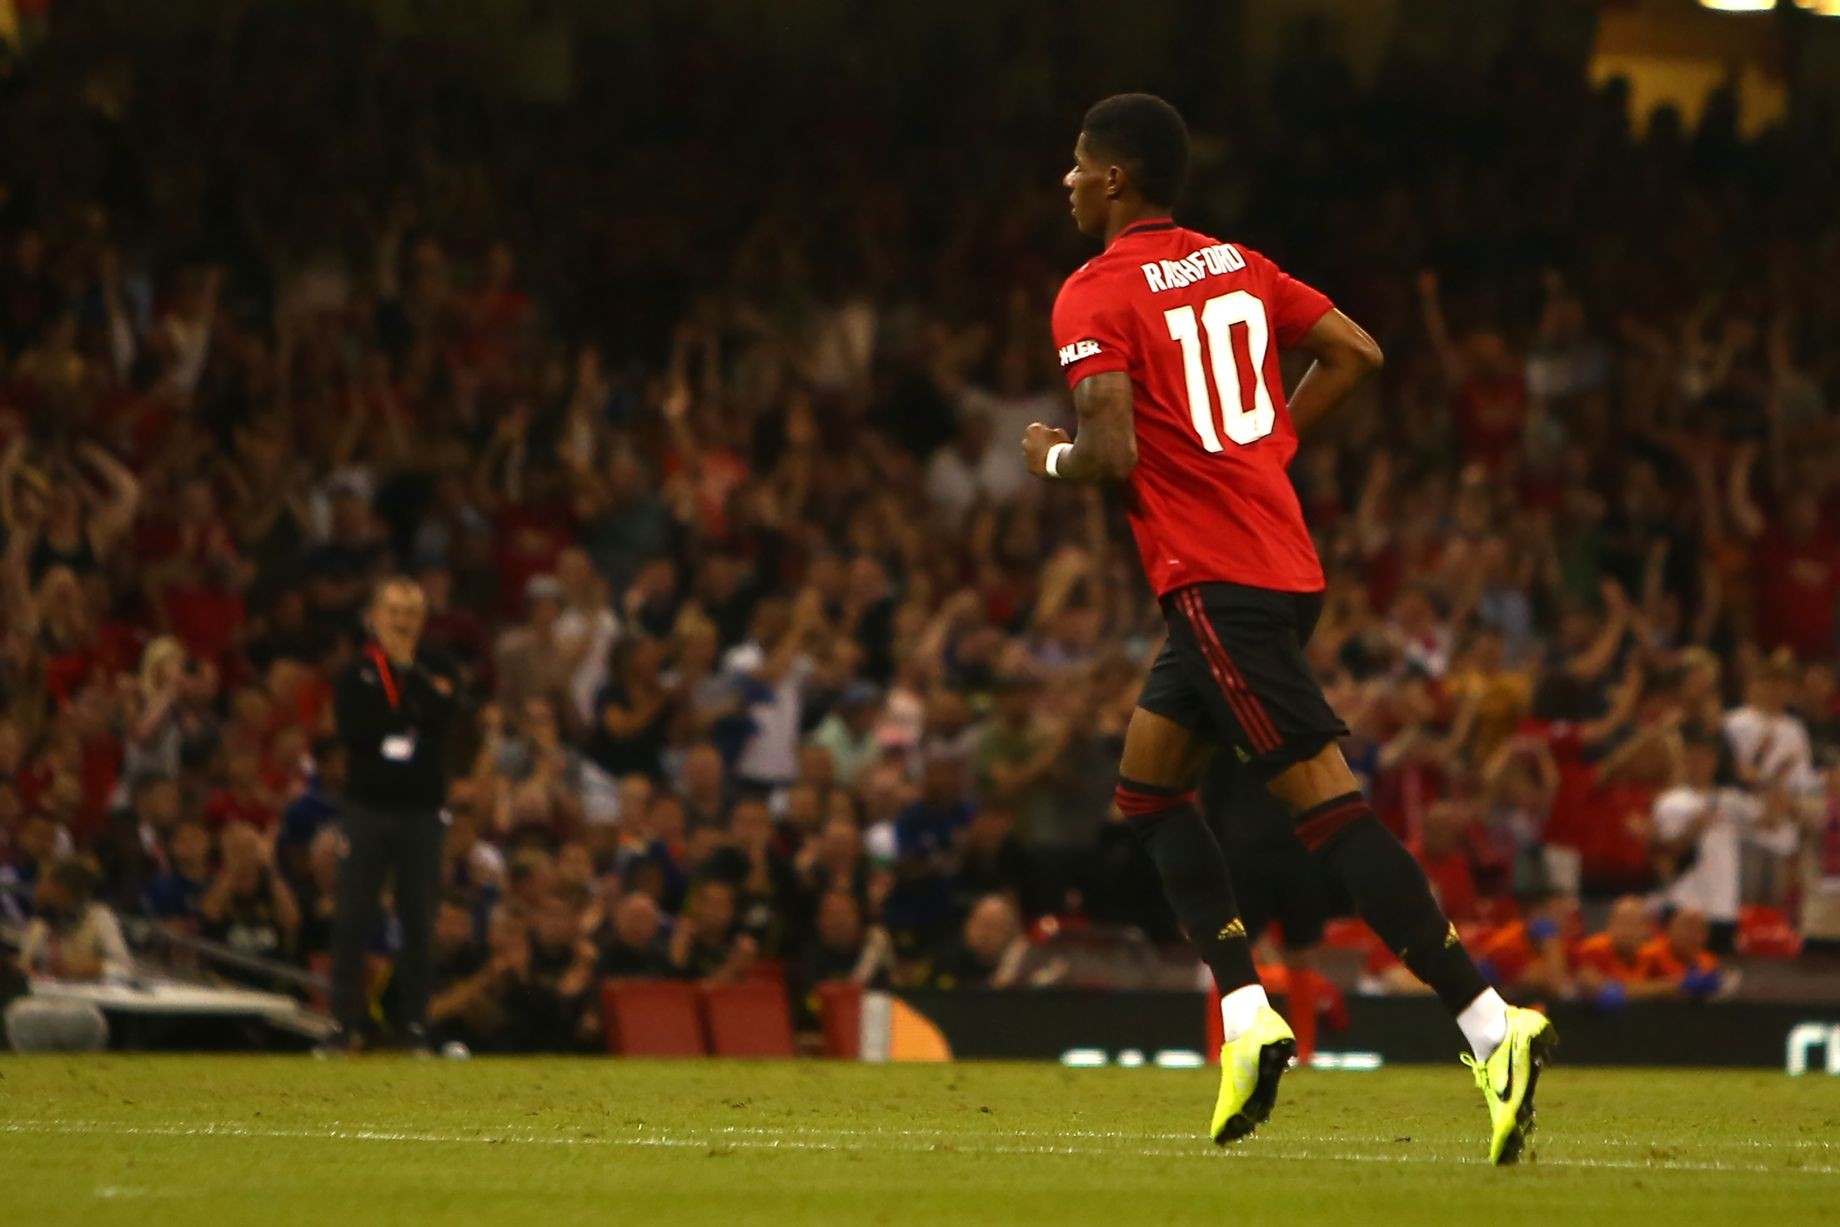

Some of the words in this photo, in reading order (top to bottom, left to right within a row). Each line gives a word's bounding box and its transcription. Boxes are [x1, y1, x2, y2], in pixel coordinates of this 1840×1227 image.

[1141, 243, 1247, 293] RASHFORD
[1058, 339, 1103, 367] HLER
[1163, 289, 1276, 453] 10
